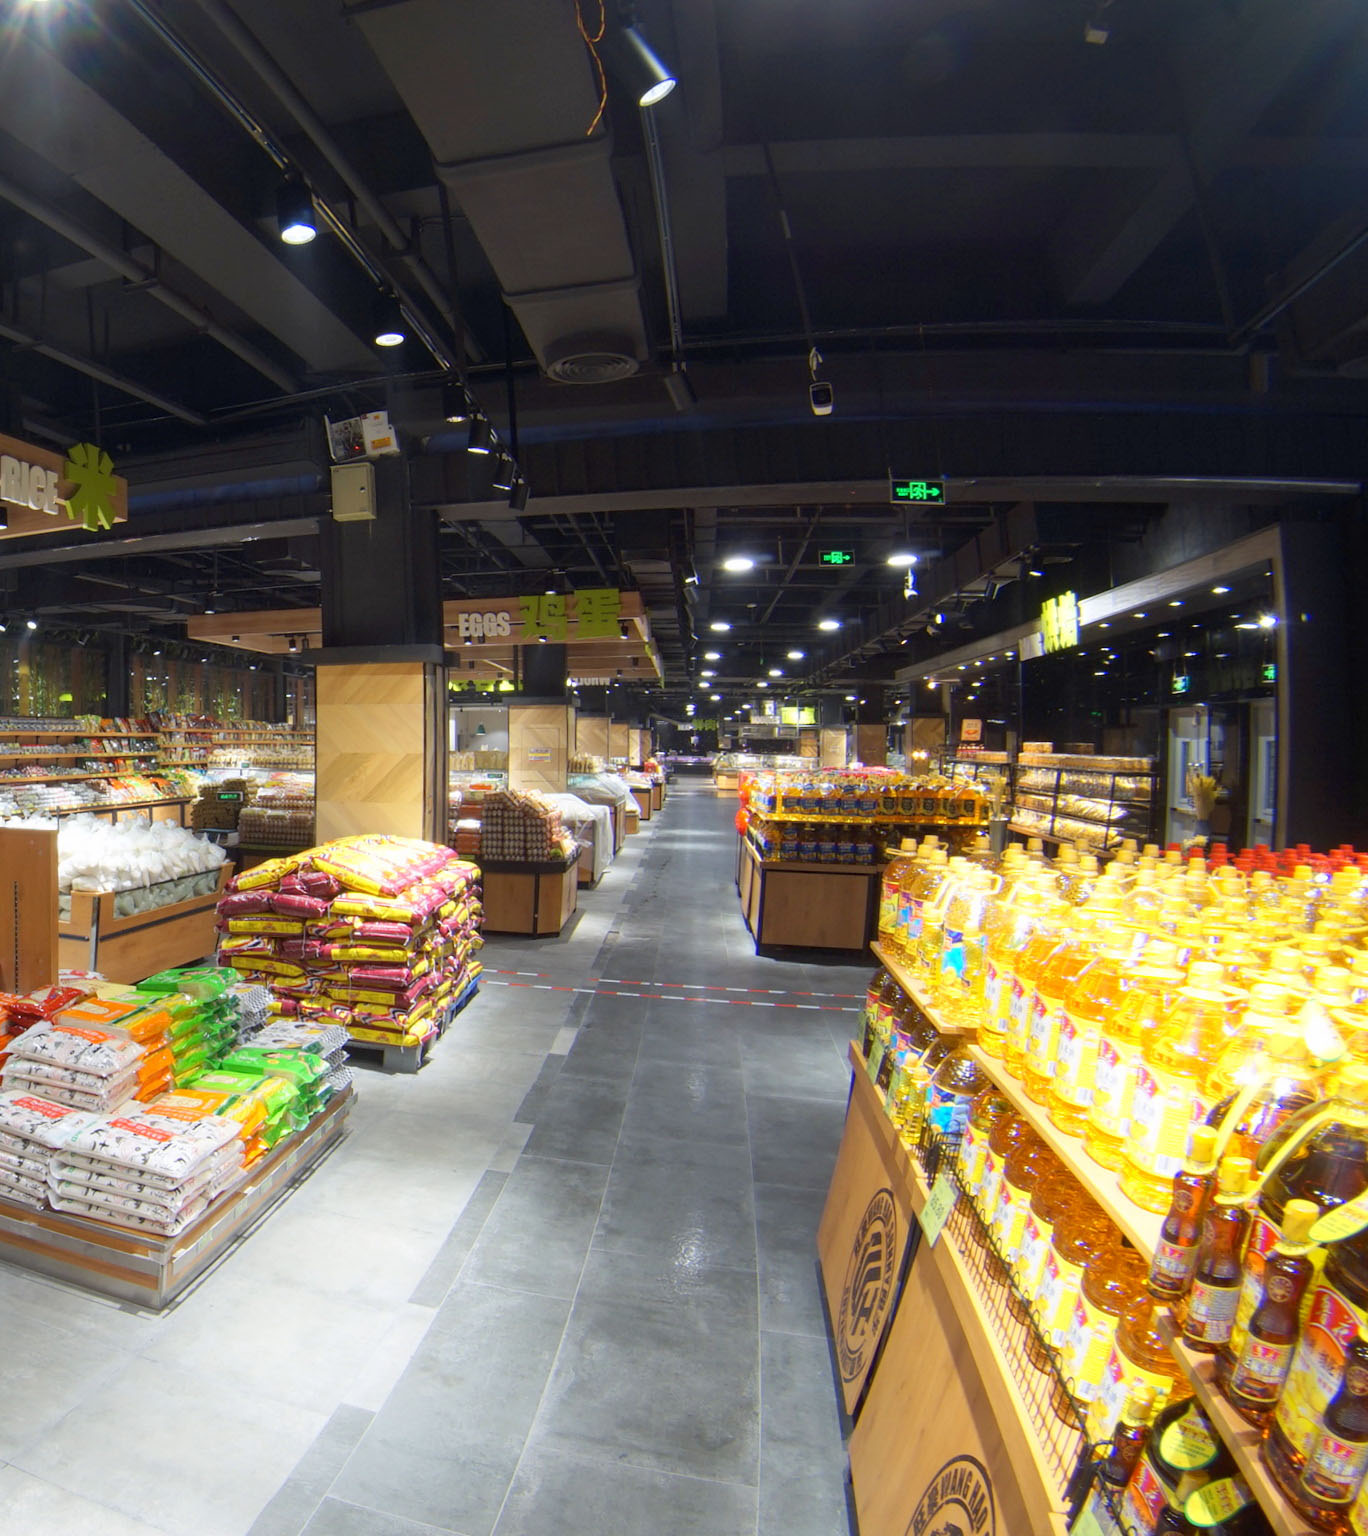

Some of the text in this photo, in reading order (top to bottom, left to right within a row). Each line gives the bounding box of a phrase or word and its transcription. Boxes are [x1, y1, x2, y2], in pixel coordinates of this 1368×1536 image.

[0, 455, 59, 515] RICE
[65, 442, 117, 531] 米
[458, 612, 511, 637] EGGS
[520, 588, 622, 640] 鸡蛋
[940, 1467, 973, 1501] WANG
